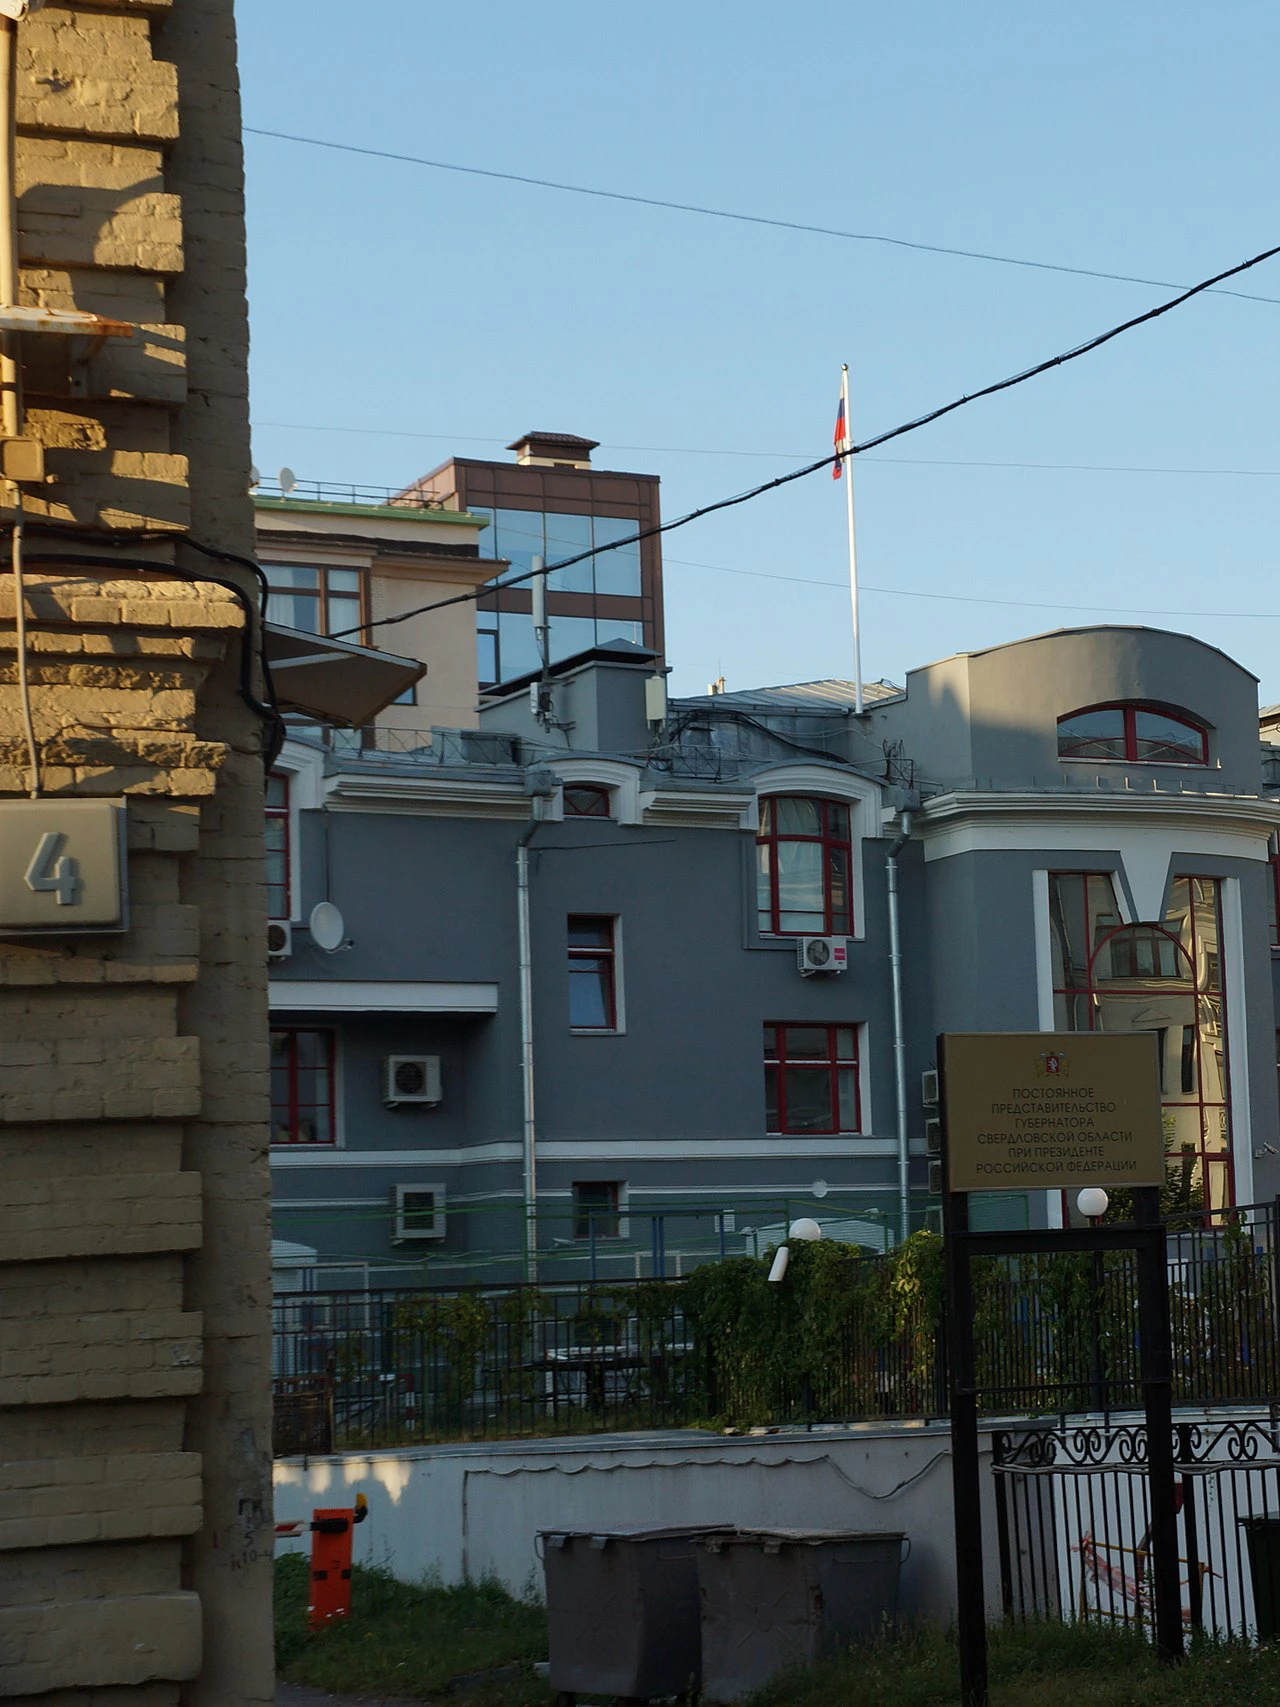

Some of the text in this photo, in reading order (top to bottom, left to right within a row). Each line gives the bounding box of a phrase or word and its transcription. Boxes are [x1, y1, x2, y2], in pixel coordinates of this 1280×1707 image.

[24, 832, 77, 905] 4
[1012, 1087, 1095, 1099] ПОСТОЯННОЕ
[991, 1102, 1117, 1114] ПРЕДСТАВИТЕЛЬСТВО
[1015, 1117, 1095, 1128] ГУБЕРНАТОРА
[977, 1131, 1133, 1144] СВЕРДЛОВСКОЙ ОБЛАСТИ
[1008, 1146, 1105, 1158] ПРИ ПРЕЗИДЕНТЕ
[976, 1160, 1137, 1174] РОССИЙСКОЙ ФЕДЕРАЦИИ
